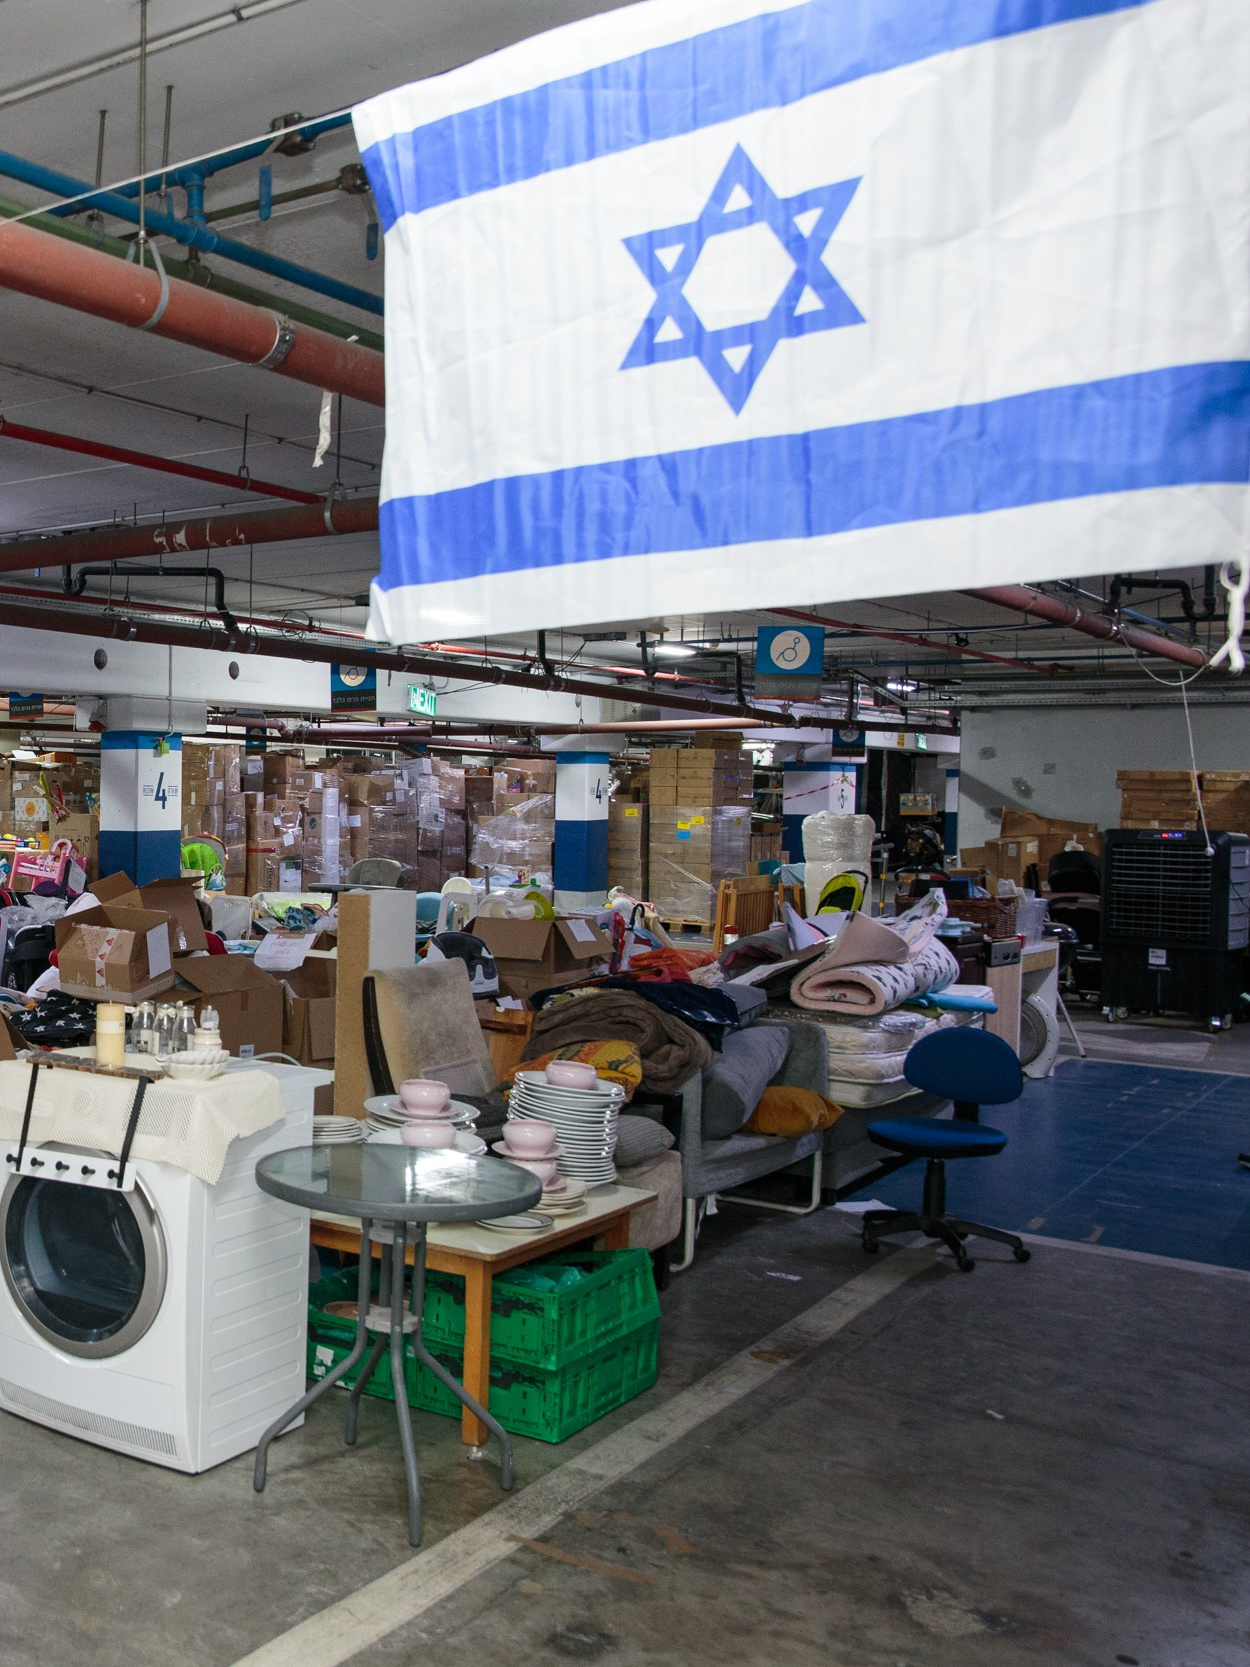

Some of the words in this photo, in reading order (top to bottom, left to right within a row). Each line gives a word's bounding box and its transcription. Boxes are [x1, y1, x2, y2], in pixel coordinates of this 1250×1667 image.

[333, 696, 346, 704] בלבד
[418, 690, 435, 716] EXIT
[154, 771, 168, 810] 4
[595, 778, 602, 805] 4
